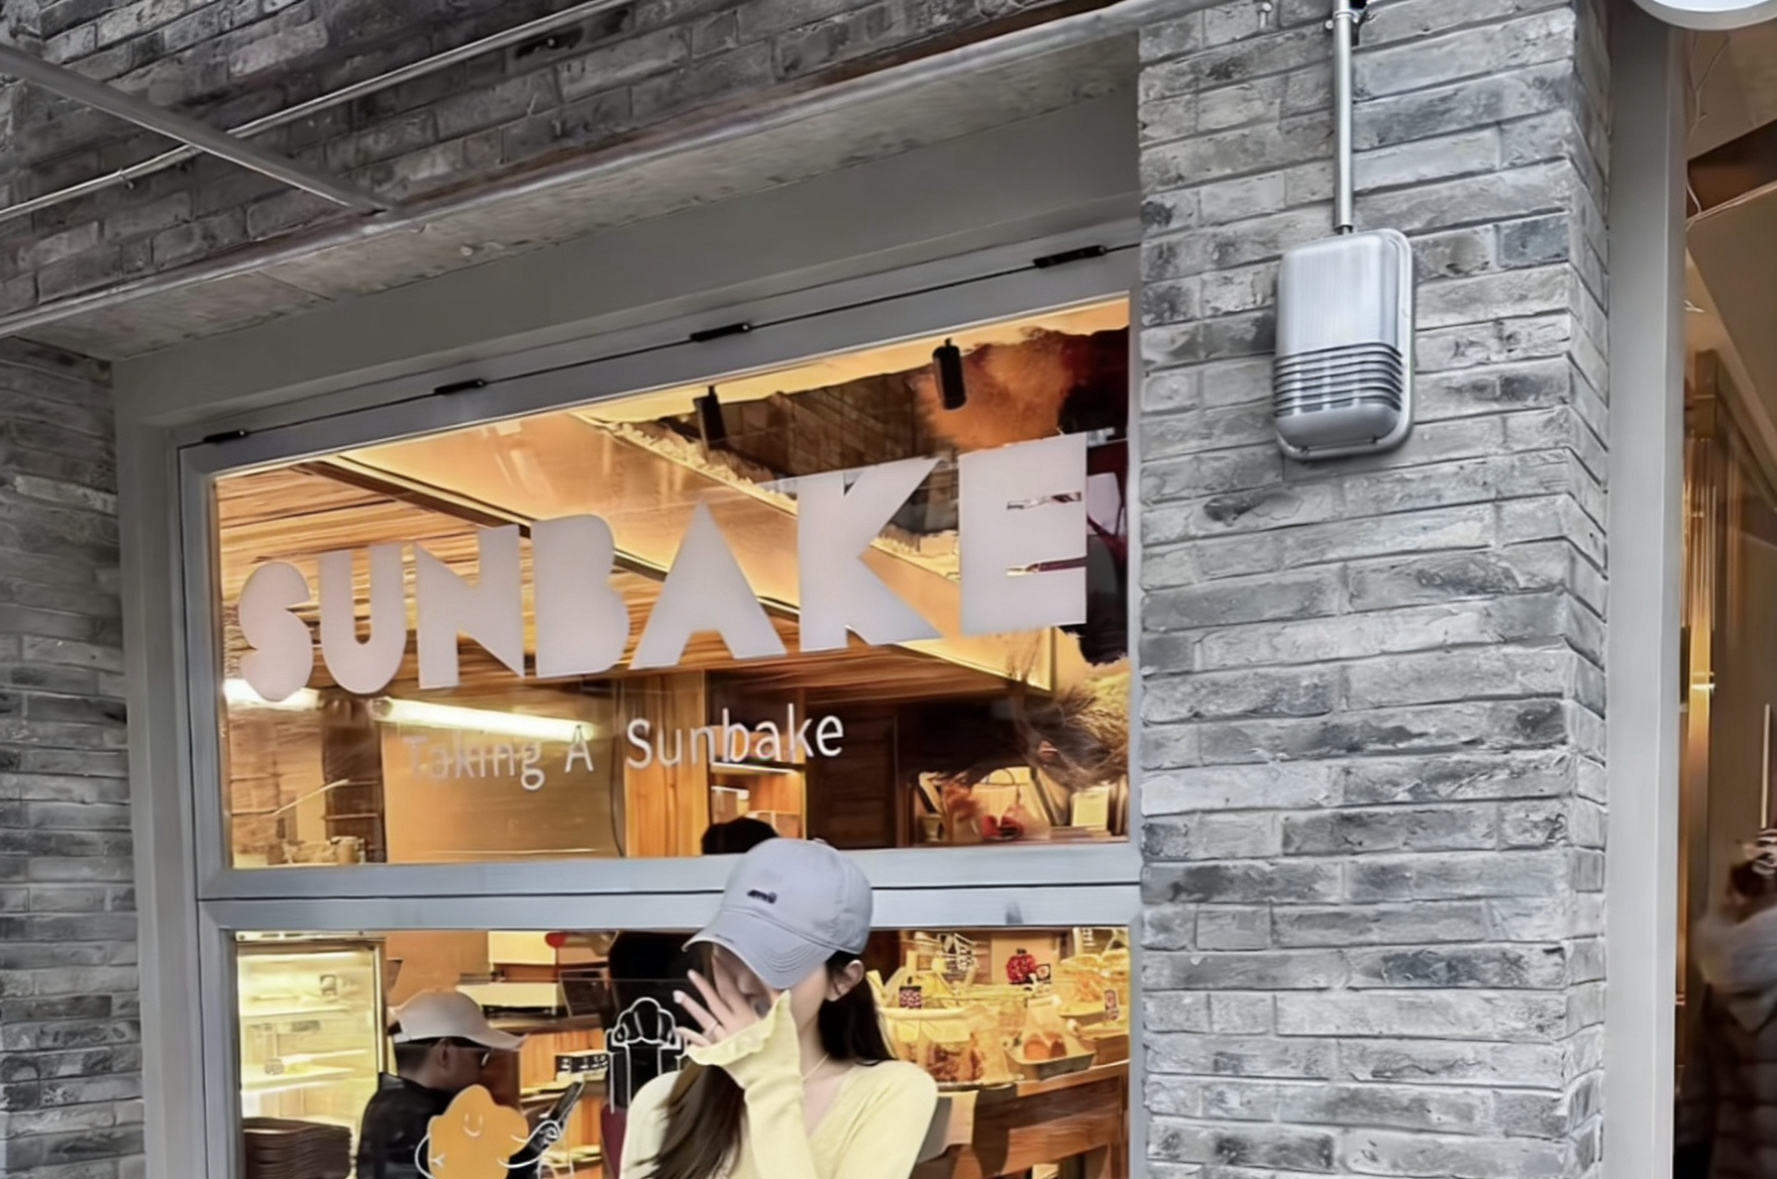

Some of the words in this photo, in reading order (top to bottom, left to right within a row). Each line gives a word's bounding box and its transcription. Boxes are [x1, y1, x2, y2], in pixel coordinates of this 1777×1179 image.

[238, 432, 1087, 702] SUNBAKE
[402, 731, 545, 790] Taking
[565, 724, 594, 773] A
[626, 702, 844, 770] Sunbake
